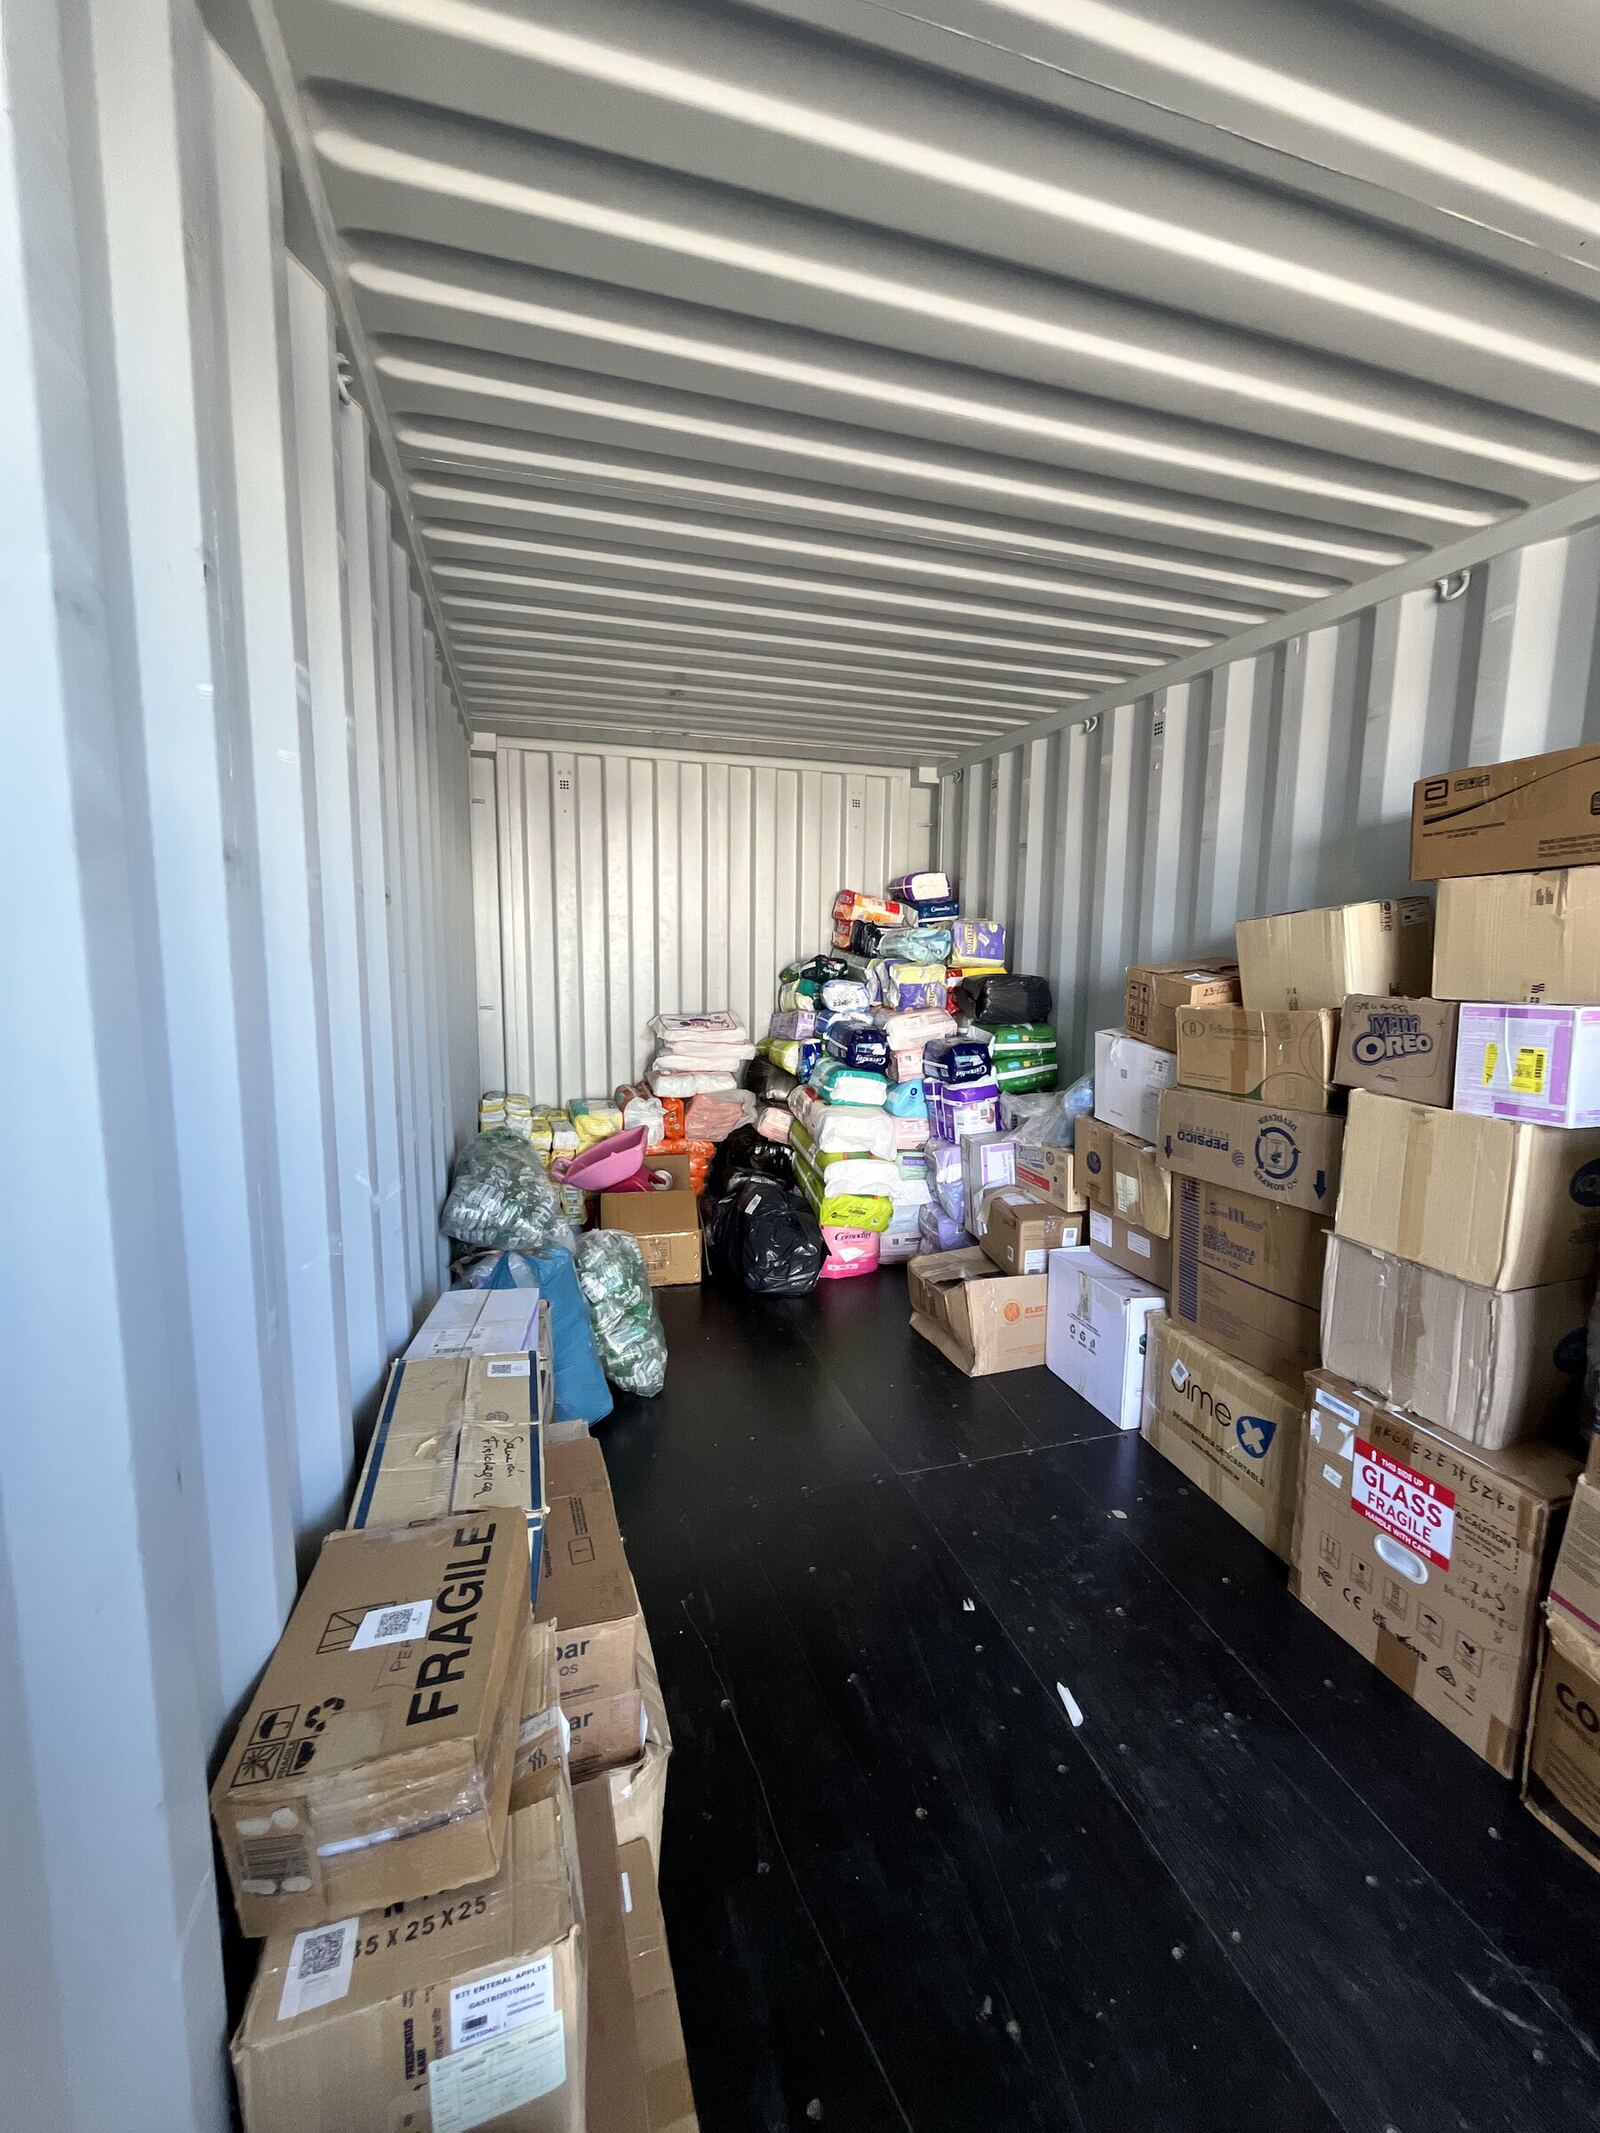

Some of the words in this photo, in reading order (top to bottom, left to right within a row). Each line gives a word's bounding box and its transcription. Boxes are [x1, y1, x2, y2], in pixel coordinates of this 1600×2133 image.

[1354, 1033, 1433, 1063] OREO
[1177, 1130, 1229, 1152] PEPSICO
[1381, 1458, 1397, 1473] THIS
[1397, 1468, 1412, 1482] SIDE
[1413, 1477, 1424, 1487] UP
[1362, 1465, 1442, 1528] GLASS
[1367, 1491, 1432, 1543] FRAGILE
[1365, 1510, 1392, 1532] HANDLE
[1392, 1528, 1412, 1546] WITH
[1411, 1540, 1432, 1559] CARE
[1464, 1513, 1512, 1548] CAUTION
[406, 1523, 496, 1726] FRAGILE
[387, 1928, 400, 1948] X
[405, 1915, 436, 1943] 25
[442, 1906, 454, 1929] X
[459, 1895, 487, 1921] 25
[455, 1990, 472, 2000] KIT
[473, 1976, 514, 1995] ENTERAL
[515, 1963, 548, 1980] APPLIX
[468, 1981, 536, 2010] GASTROSTOMIA
[404, 2017, 416, 2080] FRESENIUS
